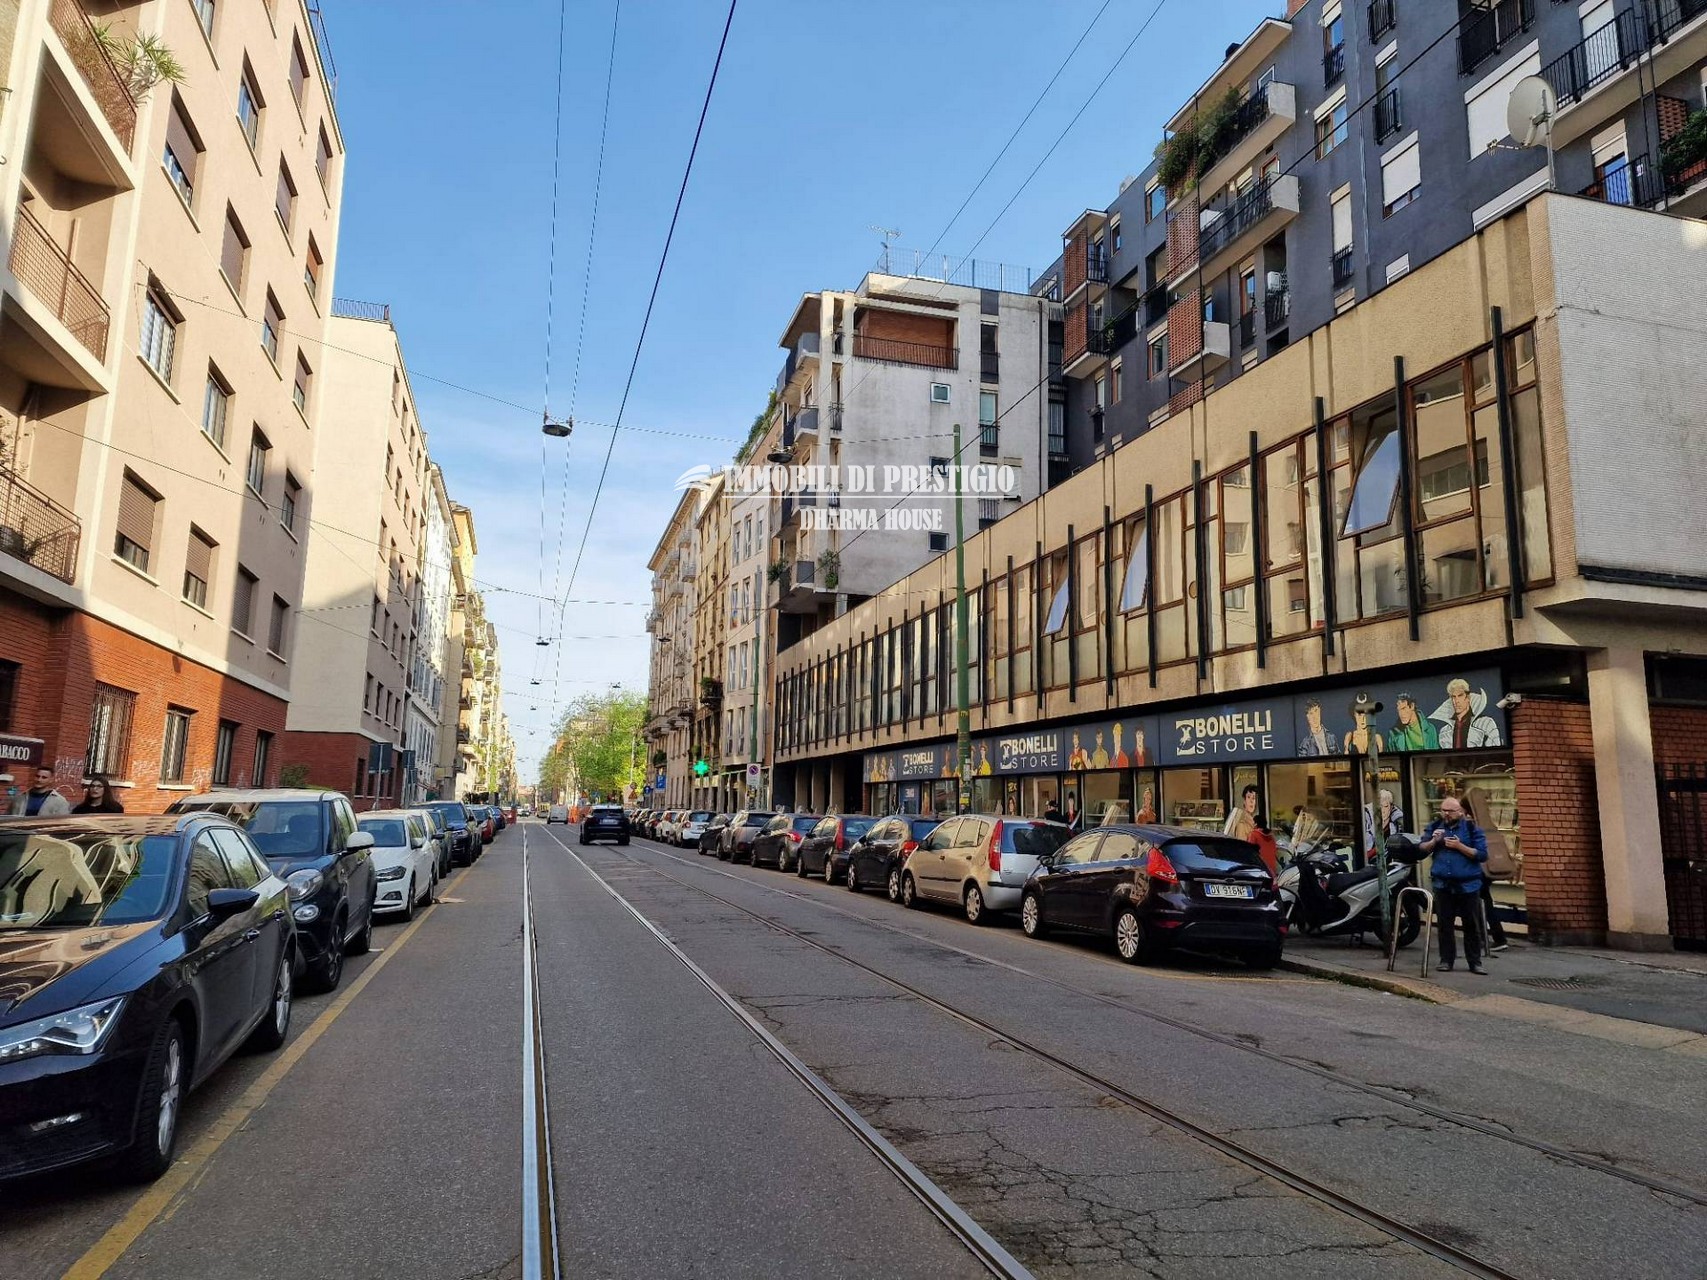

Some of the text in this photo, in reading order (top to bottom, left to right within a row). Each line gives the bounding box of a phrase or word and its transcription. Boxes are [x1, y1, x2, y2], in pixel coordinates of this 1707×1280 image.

[1195, 709, 1272, 738] BONELLI
[1011, 733, 1057, 756] BONELLI
[1195, 734, 1274, 755] STORE
[909, 764, 934, 775] STORE
[1011, 754, 1058, 769] STORE
